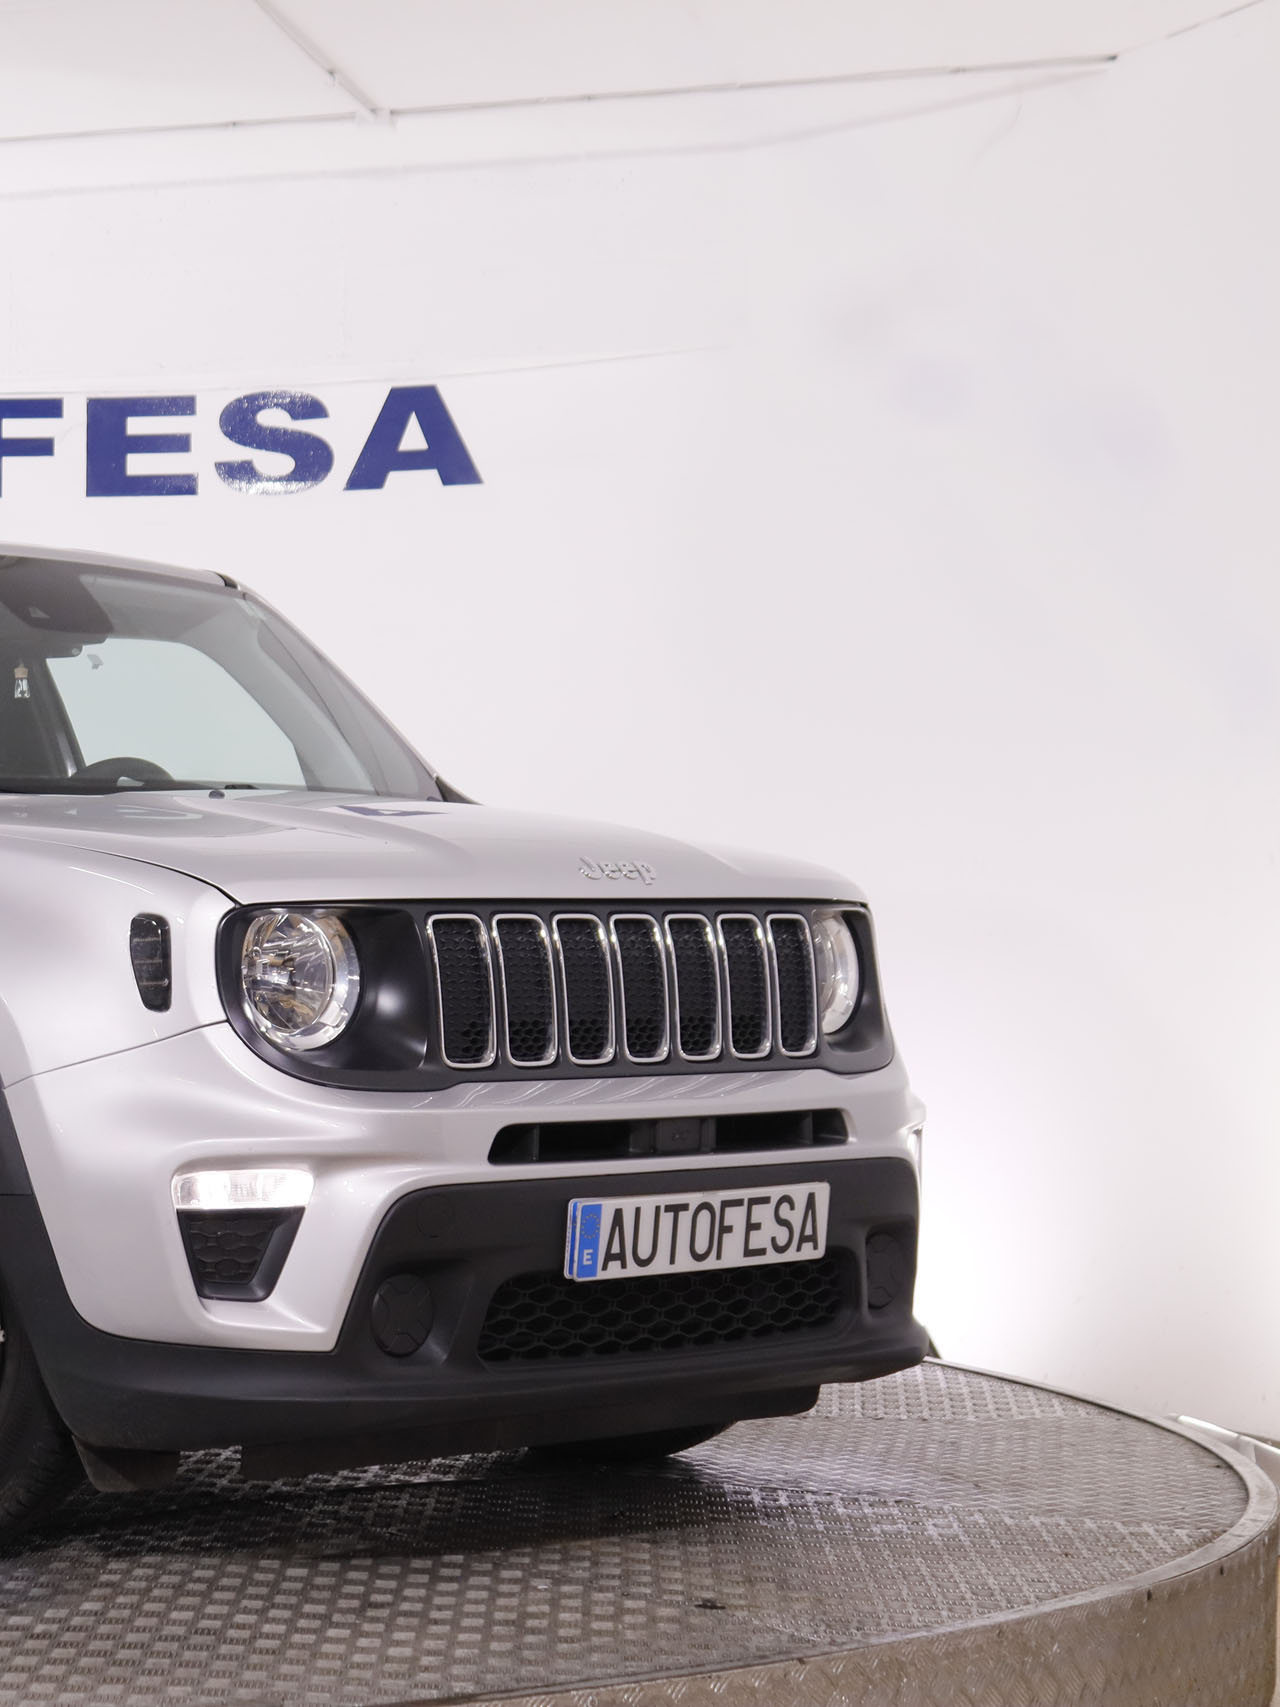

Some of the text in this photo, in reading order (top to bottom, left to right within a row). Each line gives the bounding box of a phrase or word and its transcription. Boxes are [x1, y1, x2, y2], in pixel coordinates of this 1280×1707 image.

[578, 856, 656, 886] Jeep
[582, 1248, 594, 1266] E
[601, 1191, 818, 1271] AUTOFESA
